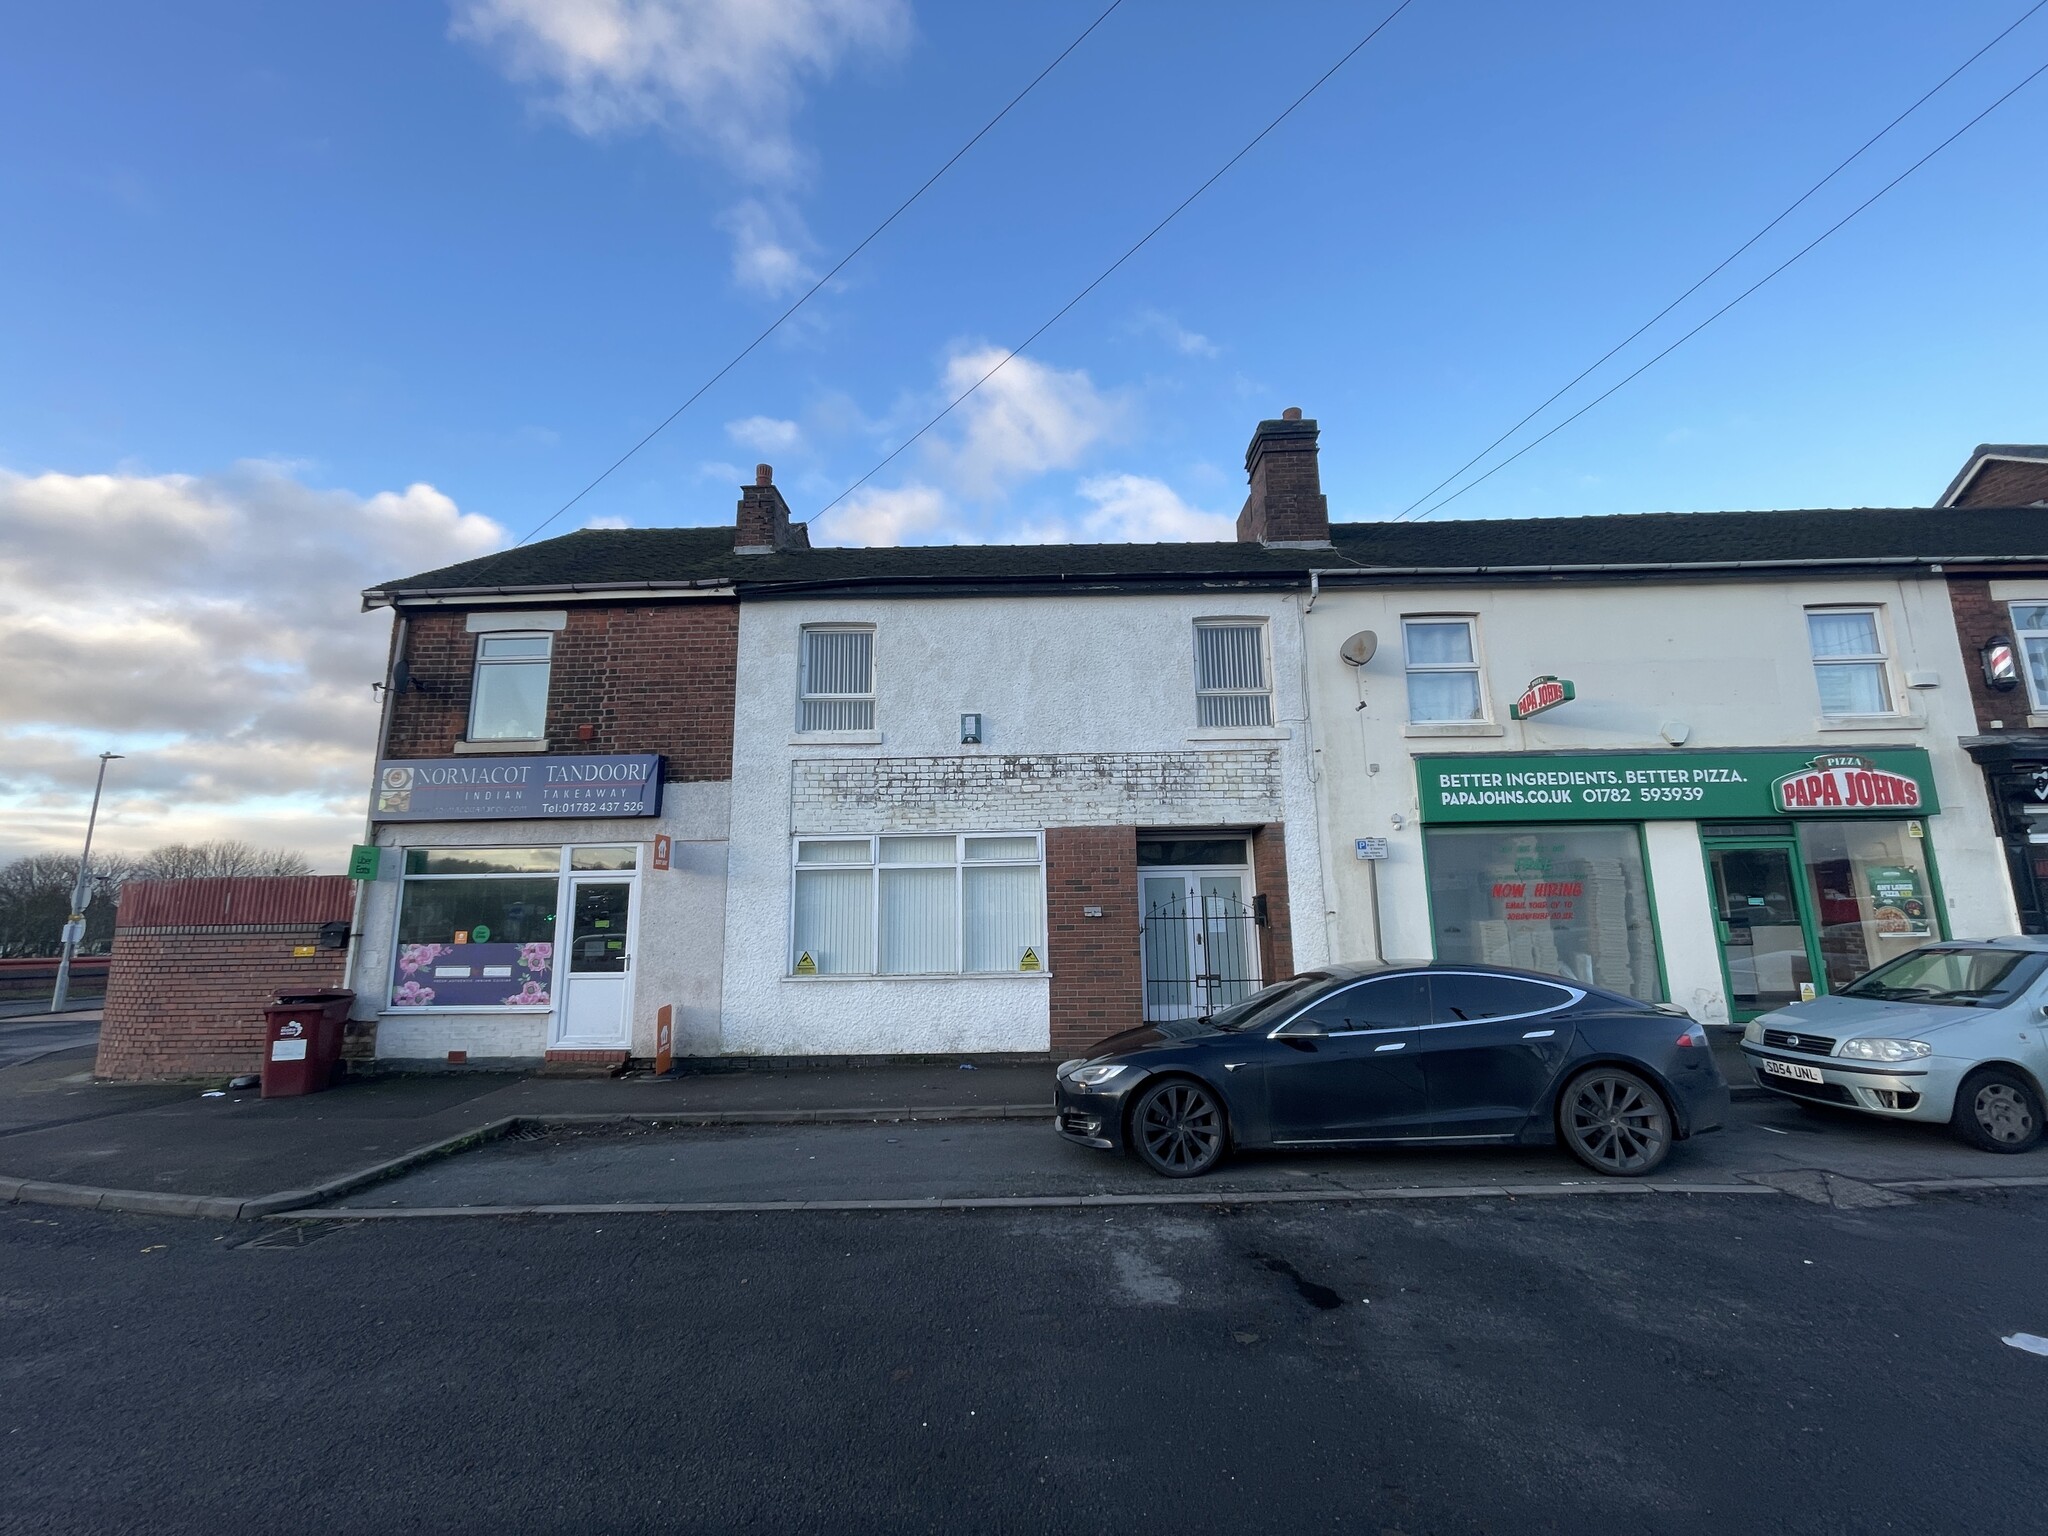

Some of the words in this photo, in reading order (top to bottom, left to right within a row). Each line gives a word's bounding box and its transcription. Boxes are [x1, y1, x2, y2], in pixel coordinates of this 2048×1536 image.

[1518, 689, 1538, 715] PAPA
[1827, 757, 1861, 767] PIZZA
[418, 766, 531, 785] NORMACOT
[545, 763, 647, 782] TANDOORI
[1439, 773, 1502, 788] BETTER
[1506, 771, 1622, 786] INGREDIENTS.
[1625, 770, 1690, 784] BETTER
[1692, 769, 1748, 783] PIZZA.
[465, 791, 522, 801] INDIAN
[543, 788, 627, 799] TAKEAWAY
[1441, 789, 1572, 806] PAPAJOHNS.CO.UK
[1582, 788, 1632, 803] 01782
[1640, 787, 1704, 802] 593939
[1783, 772, 1842, 807] PAPA
[542, 802, 596, 813] Tel:01782
[599, 802, 620, 811] 437
[623, 801, 644, 811] 526
[1492, 883, 1526, 898] NOW
[1534, 881, 1584, 897] HIRING
[1766, 1061, 1792, 1076] SD54
[1793, 1066, 1818, 1081] UNL
